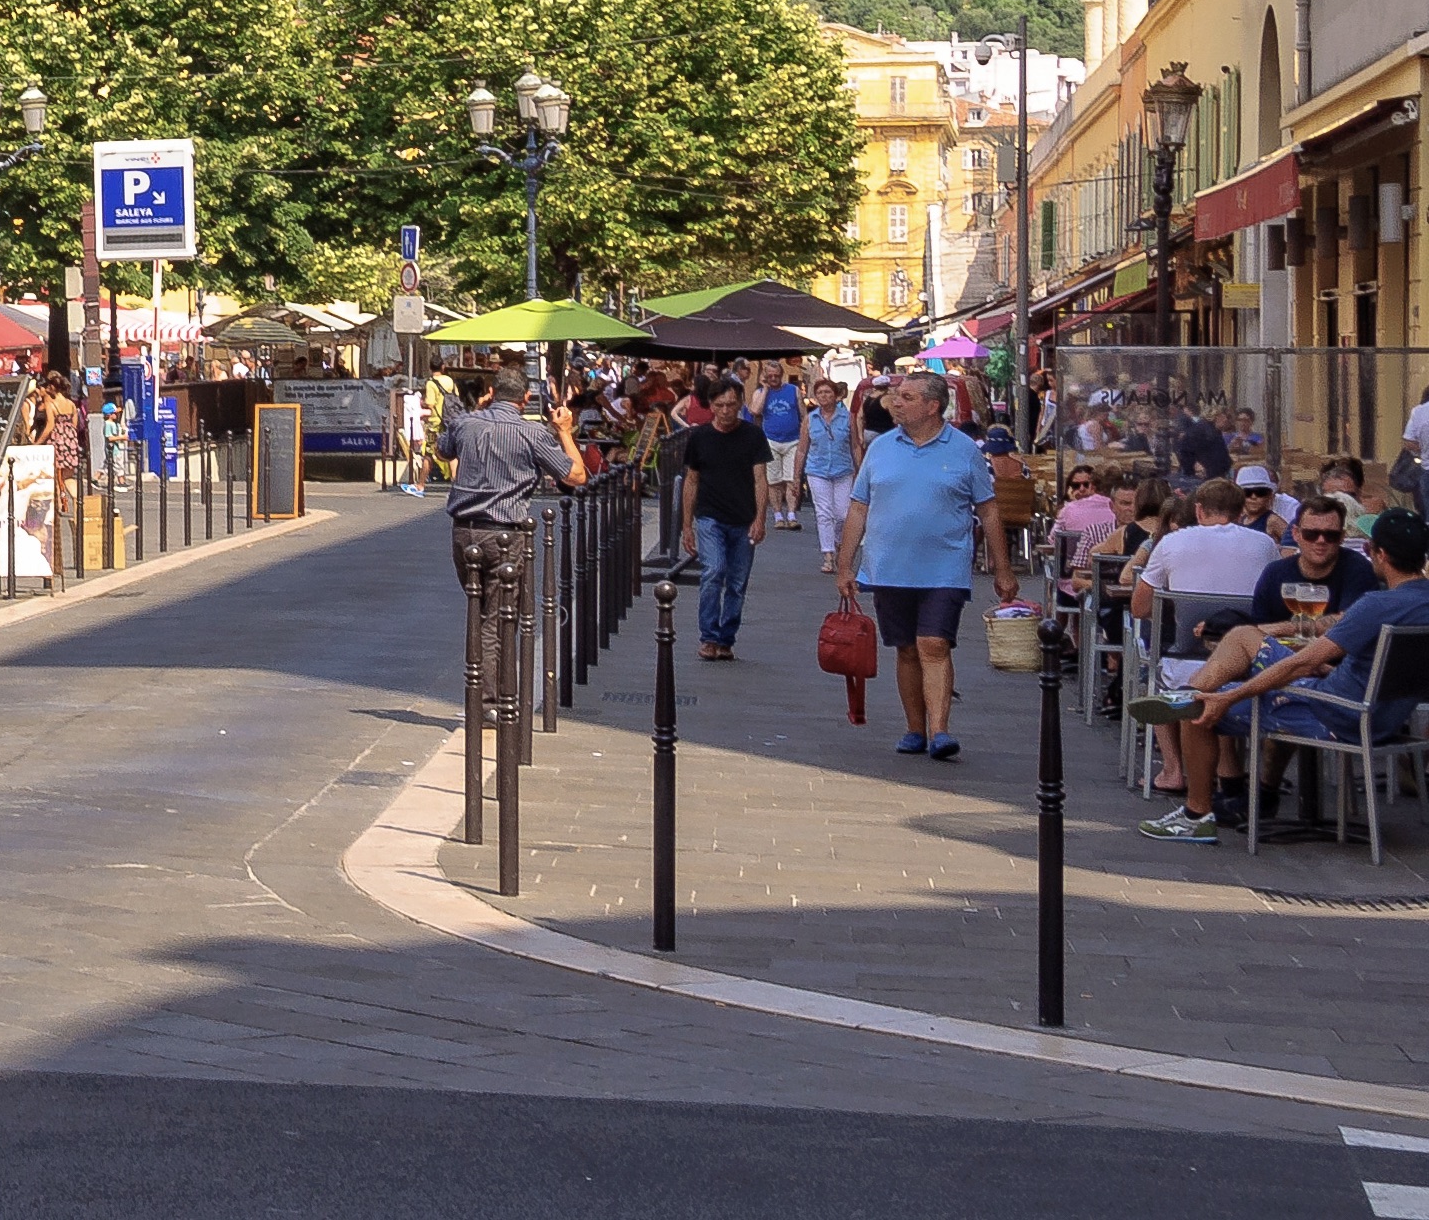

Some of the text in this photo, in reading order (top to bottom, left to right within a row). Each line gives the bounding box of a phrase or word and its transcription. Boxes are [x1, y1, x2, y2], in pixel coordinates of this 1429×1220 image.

[123, 170, 151, 206] P
[114, 207, 154, 218] SALEYA
[341, 437, 376, 446] SALEYA
